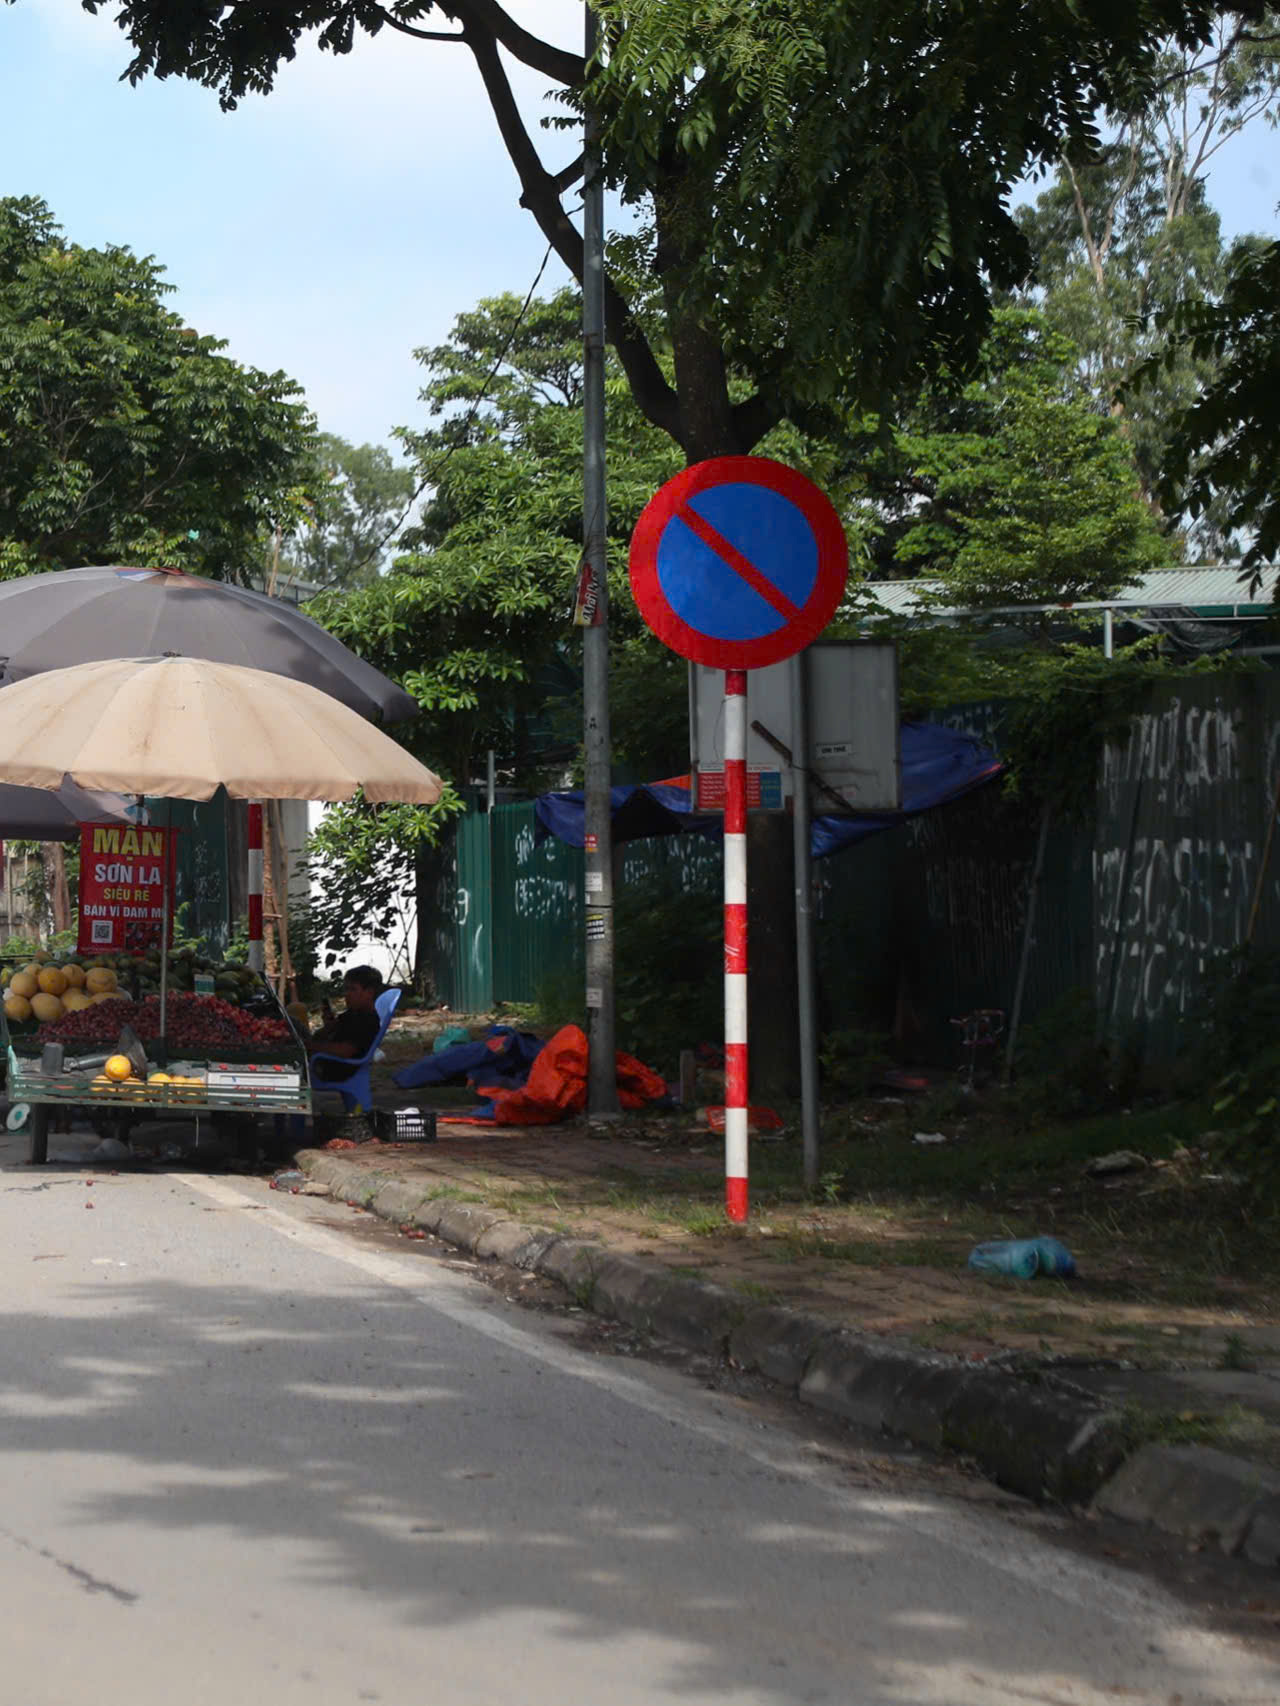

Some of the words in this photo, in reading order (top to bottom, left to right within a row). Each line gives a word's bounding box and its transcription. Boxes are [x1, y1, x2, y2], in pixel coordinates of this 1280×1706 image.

[93, 824, 163, 861] MẬN
[95, 863, 132, 884] SƠN
[139, 866, 161, 885] LA
[103, 886, 131, 901] SIÊU
